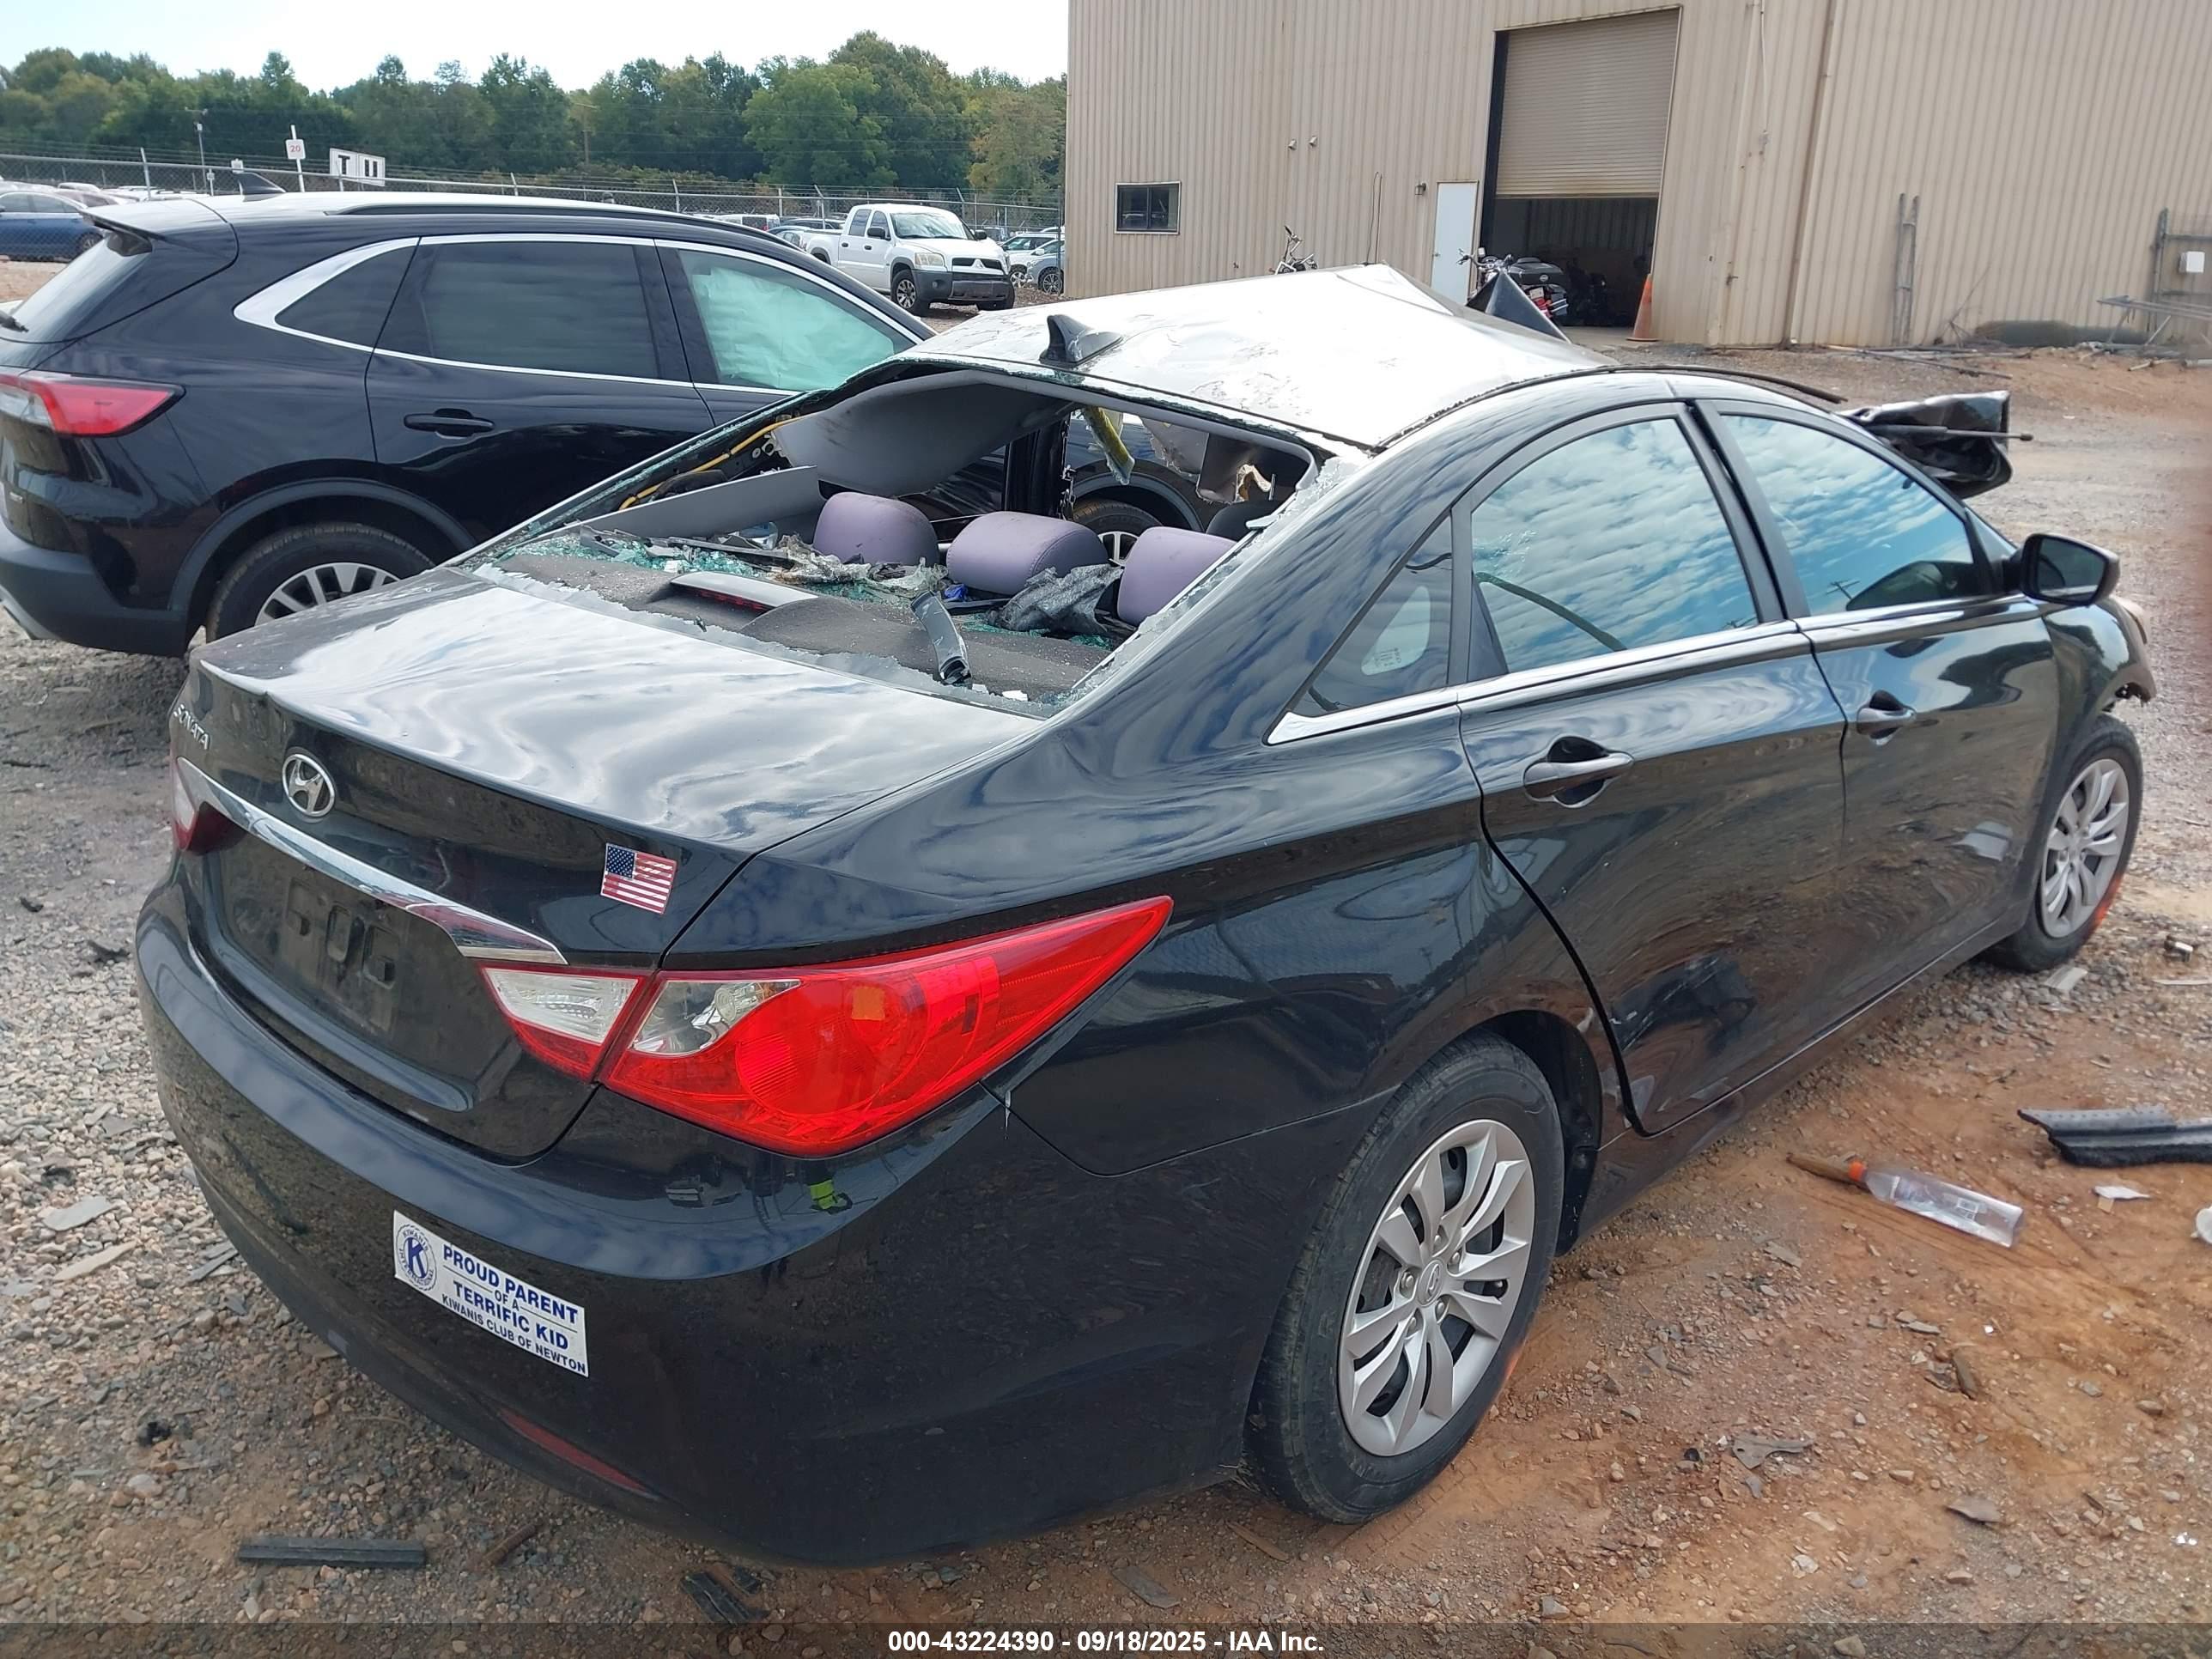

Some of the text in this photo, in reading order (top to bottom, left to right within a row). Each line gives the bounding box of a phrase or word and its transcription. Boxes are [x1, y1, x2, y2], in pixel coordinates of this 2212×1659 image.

[173, 703, 209, 750] SONATA
[443, 1243, 578, 1324] PROUD PARENT
[453, 1280, 568, 1351] TERRIFIC KID
[495, 1289, 520, 1311] OF A
[441, 1293, 586, 1374] KIWANIS CLUB OF NEWTON
